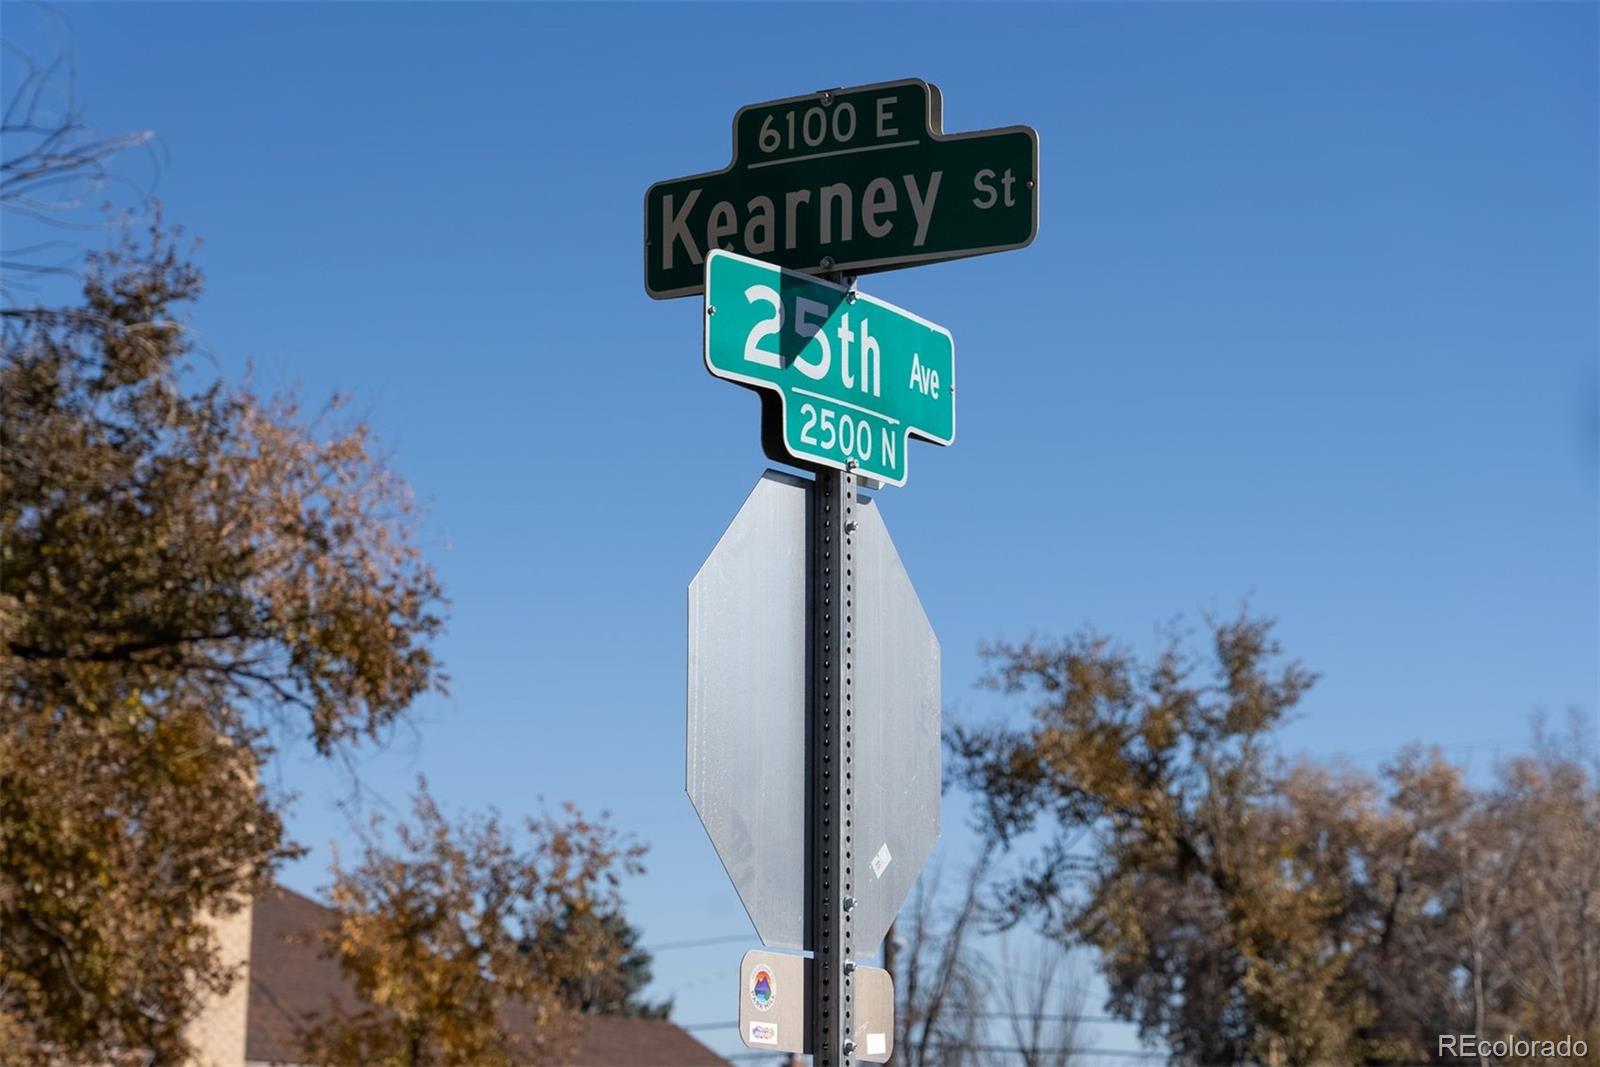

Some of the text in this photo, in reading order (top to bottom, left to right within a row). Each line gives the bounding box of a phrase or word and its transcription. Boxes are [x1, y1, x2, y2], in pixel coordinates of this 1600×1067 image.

[758, 96, 900, 153] 6100 E
[661, 167, 1016, 271] Kearney St
[743, 284, 940, 400] 25th Ave
[800, 403, 896, 470] 2500 N
